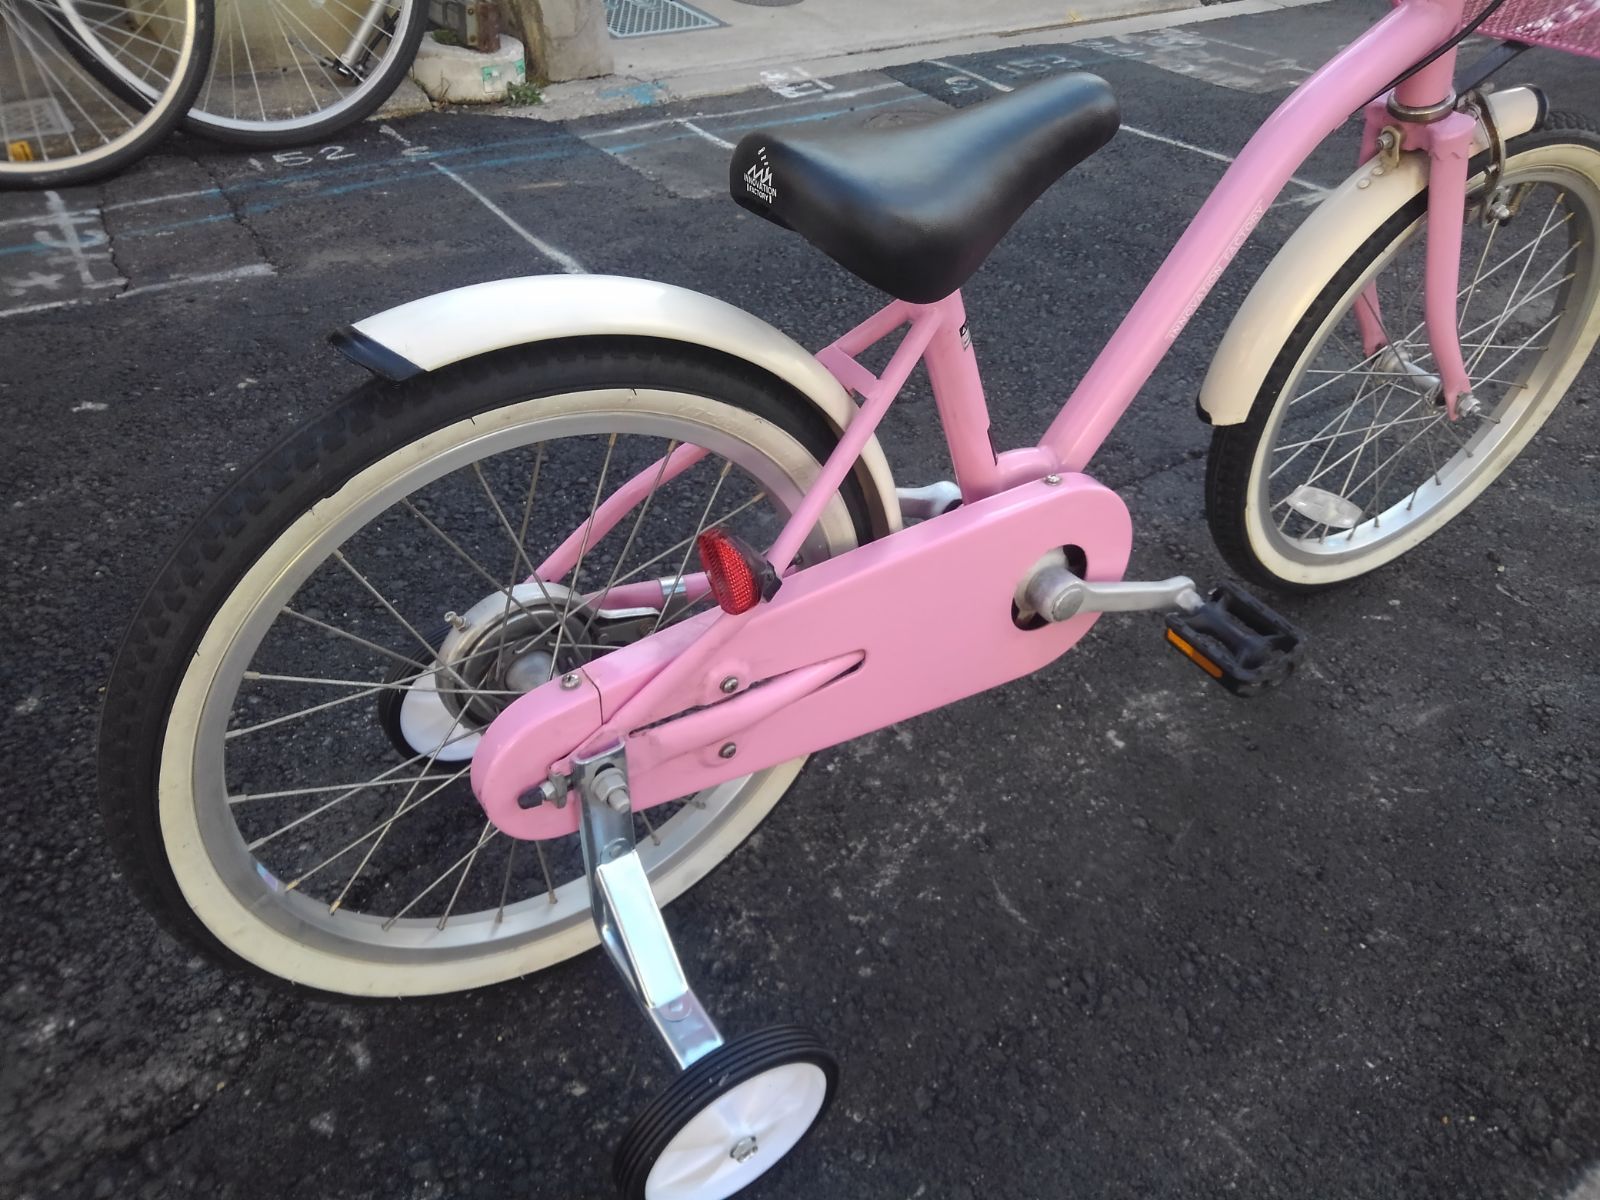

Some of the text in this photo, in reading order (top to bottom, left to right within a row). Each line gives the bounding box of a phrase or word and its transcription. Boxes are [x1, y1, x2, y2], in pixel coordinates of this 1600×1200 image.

[743, 172, 777, 198] INNOVATION
[748, 184, 770, 202] FACTORY
[1164, 199, 1263, 340] INNOVATION FACTORY
